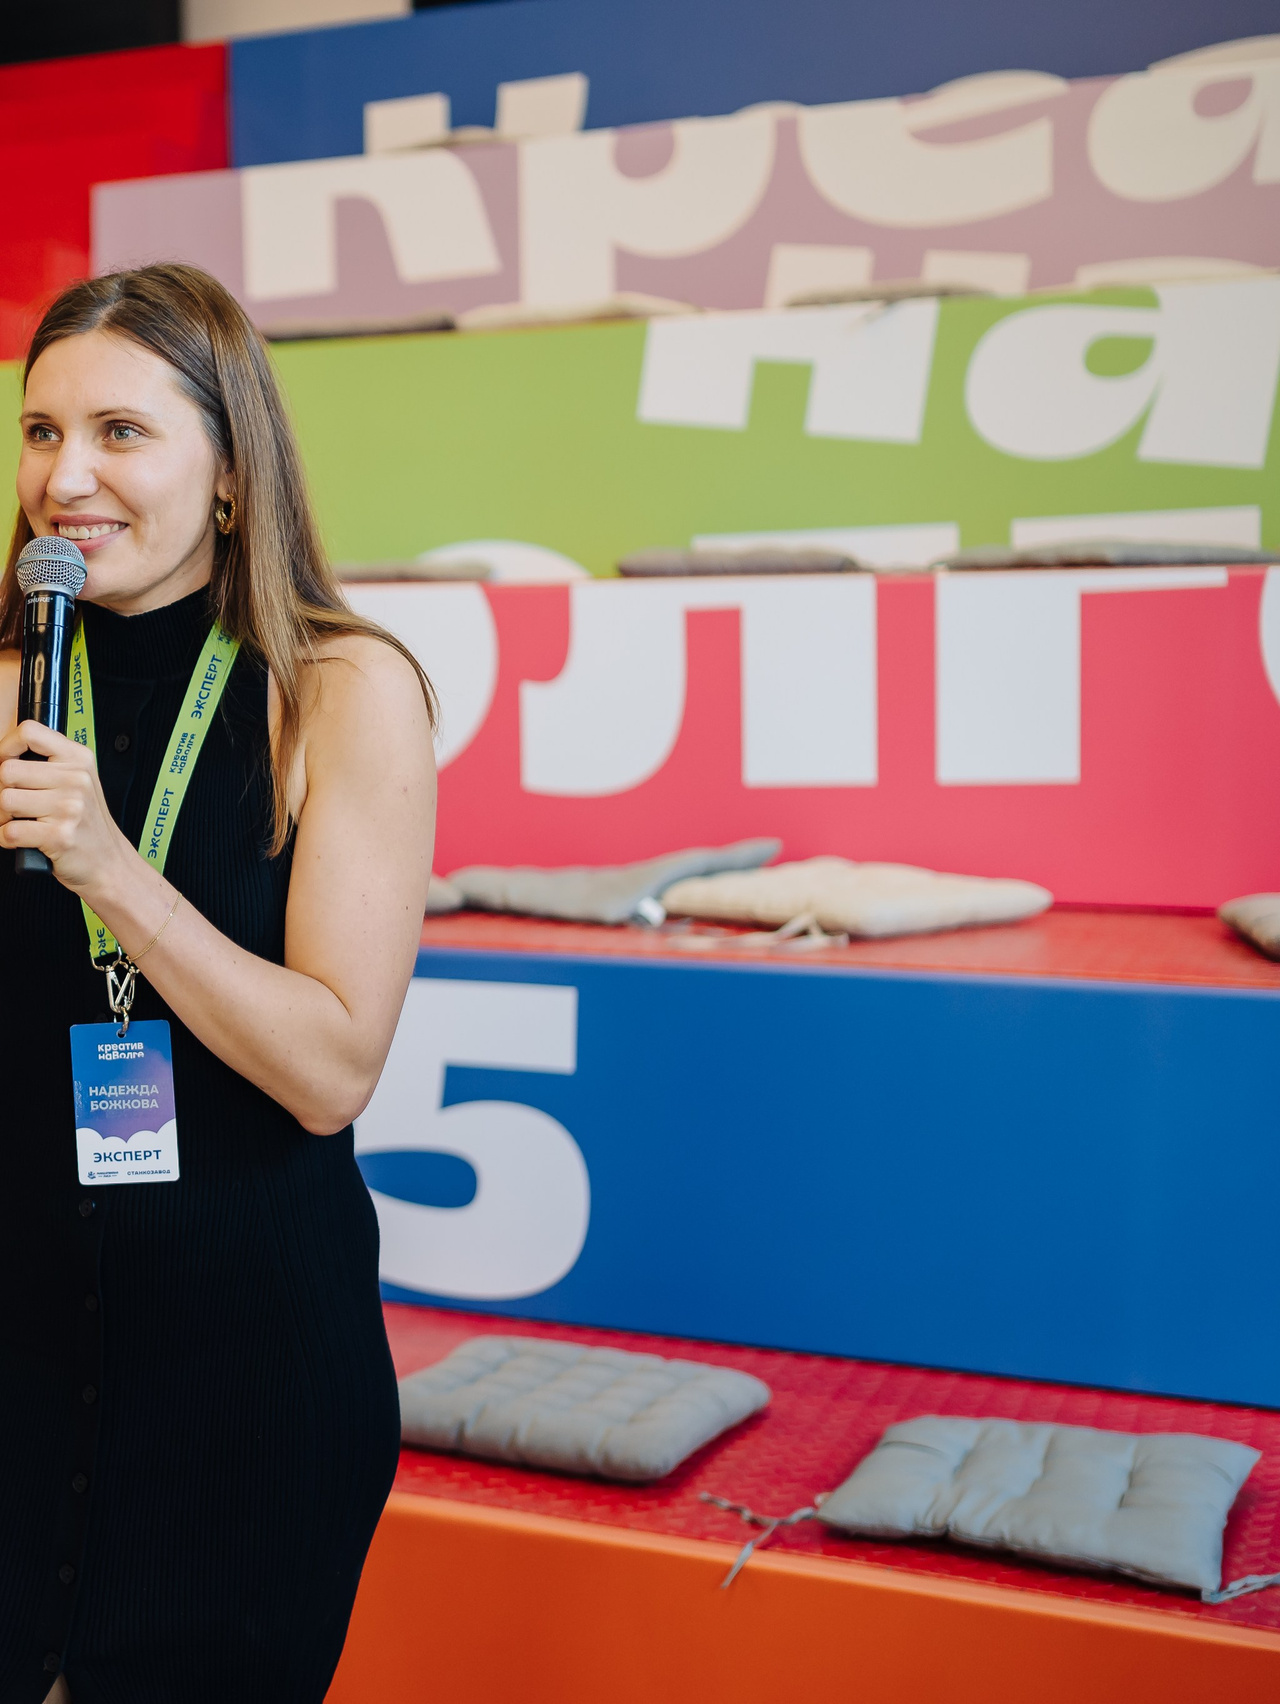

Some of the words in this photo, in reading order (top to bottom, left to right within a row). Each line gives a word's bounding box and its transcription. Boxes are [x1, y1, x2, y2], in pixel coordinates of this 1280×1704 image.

[74, 652, 84, 715] ЭКСПЕРТ
[191, 654, 223, 719] ЭКСПЕРТ
[169, 732, 189, 773] креатив
[147, 788, 175, 859] ЭКСПЕРТ
[97, 1042, 144, 1053] креатив
[89, 1085, 159, 1097] НАДЕЖДА
[90, 1099, 159, 1112] БОЖКОВА
[93, 1150, 162, 1163] ЭКСПЕРТ
